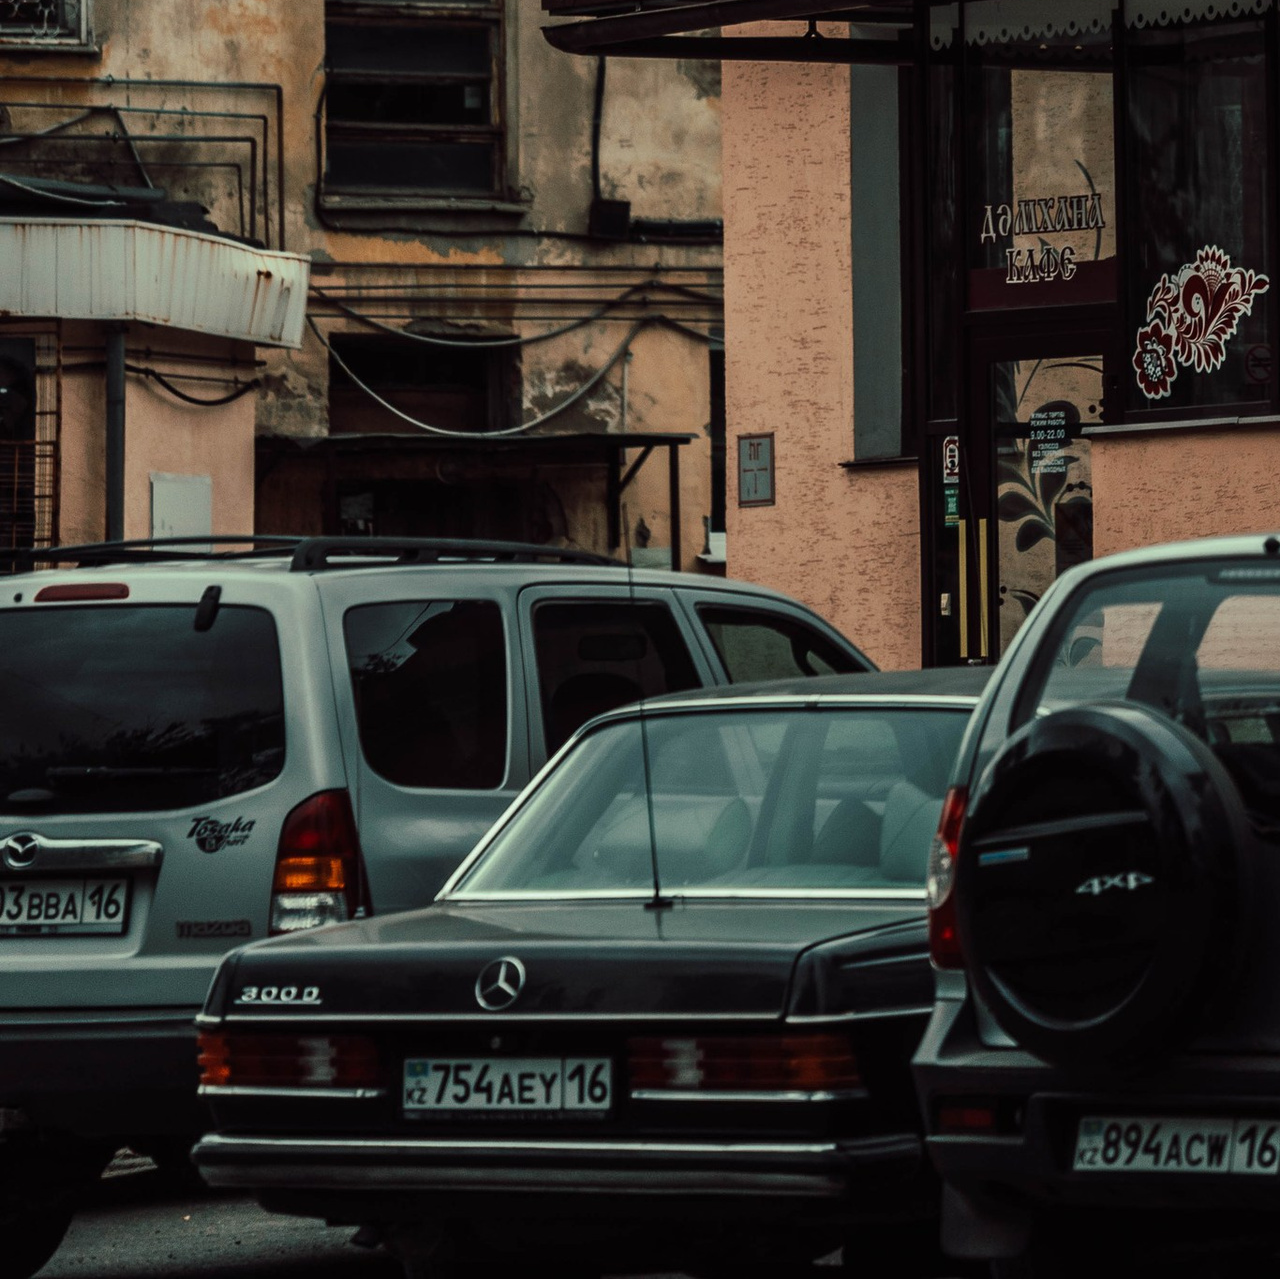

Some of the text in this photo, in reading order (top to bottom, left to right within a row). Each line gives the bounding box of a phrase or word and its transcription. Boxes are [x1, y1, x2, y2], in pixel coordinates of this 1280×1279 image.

[981, 192, 1106, 244] ДӘМХАНА
[1006, 245, 1077, 284] КАФЕ
[1030, 429, 1066, 440] 9.00-22.00
[88, 883, 121, 920] 16
[432, 1064, 557, 1104] 754AEY
[567, 1063, 608, 1104] 16
[1102, 1122, 1228, 1167] 894ACW
[1238, 1124, 1278, 1168] 16
